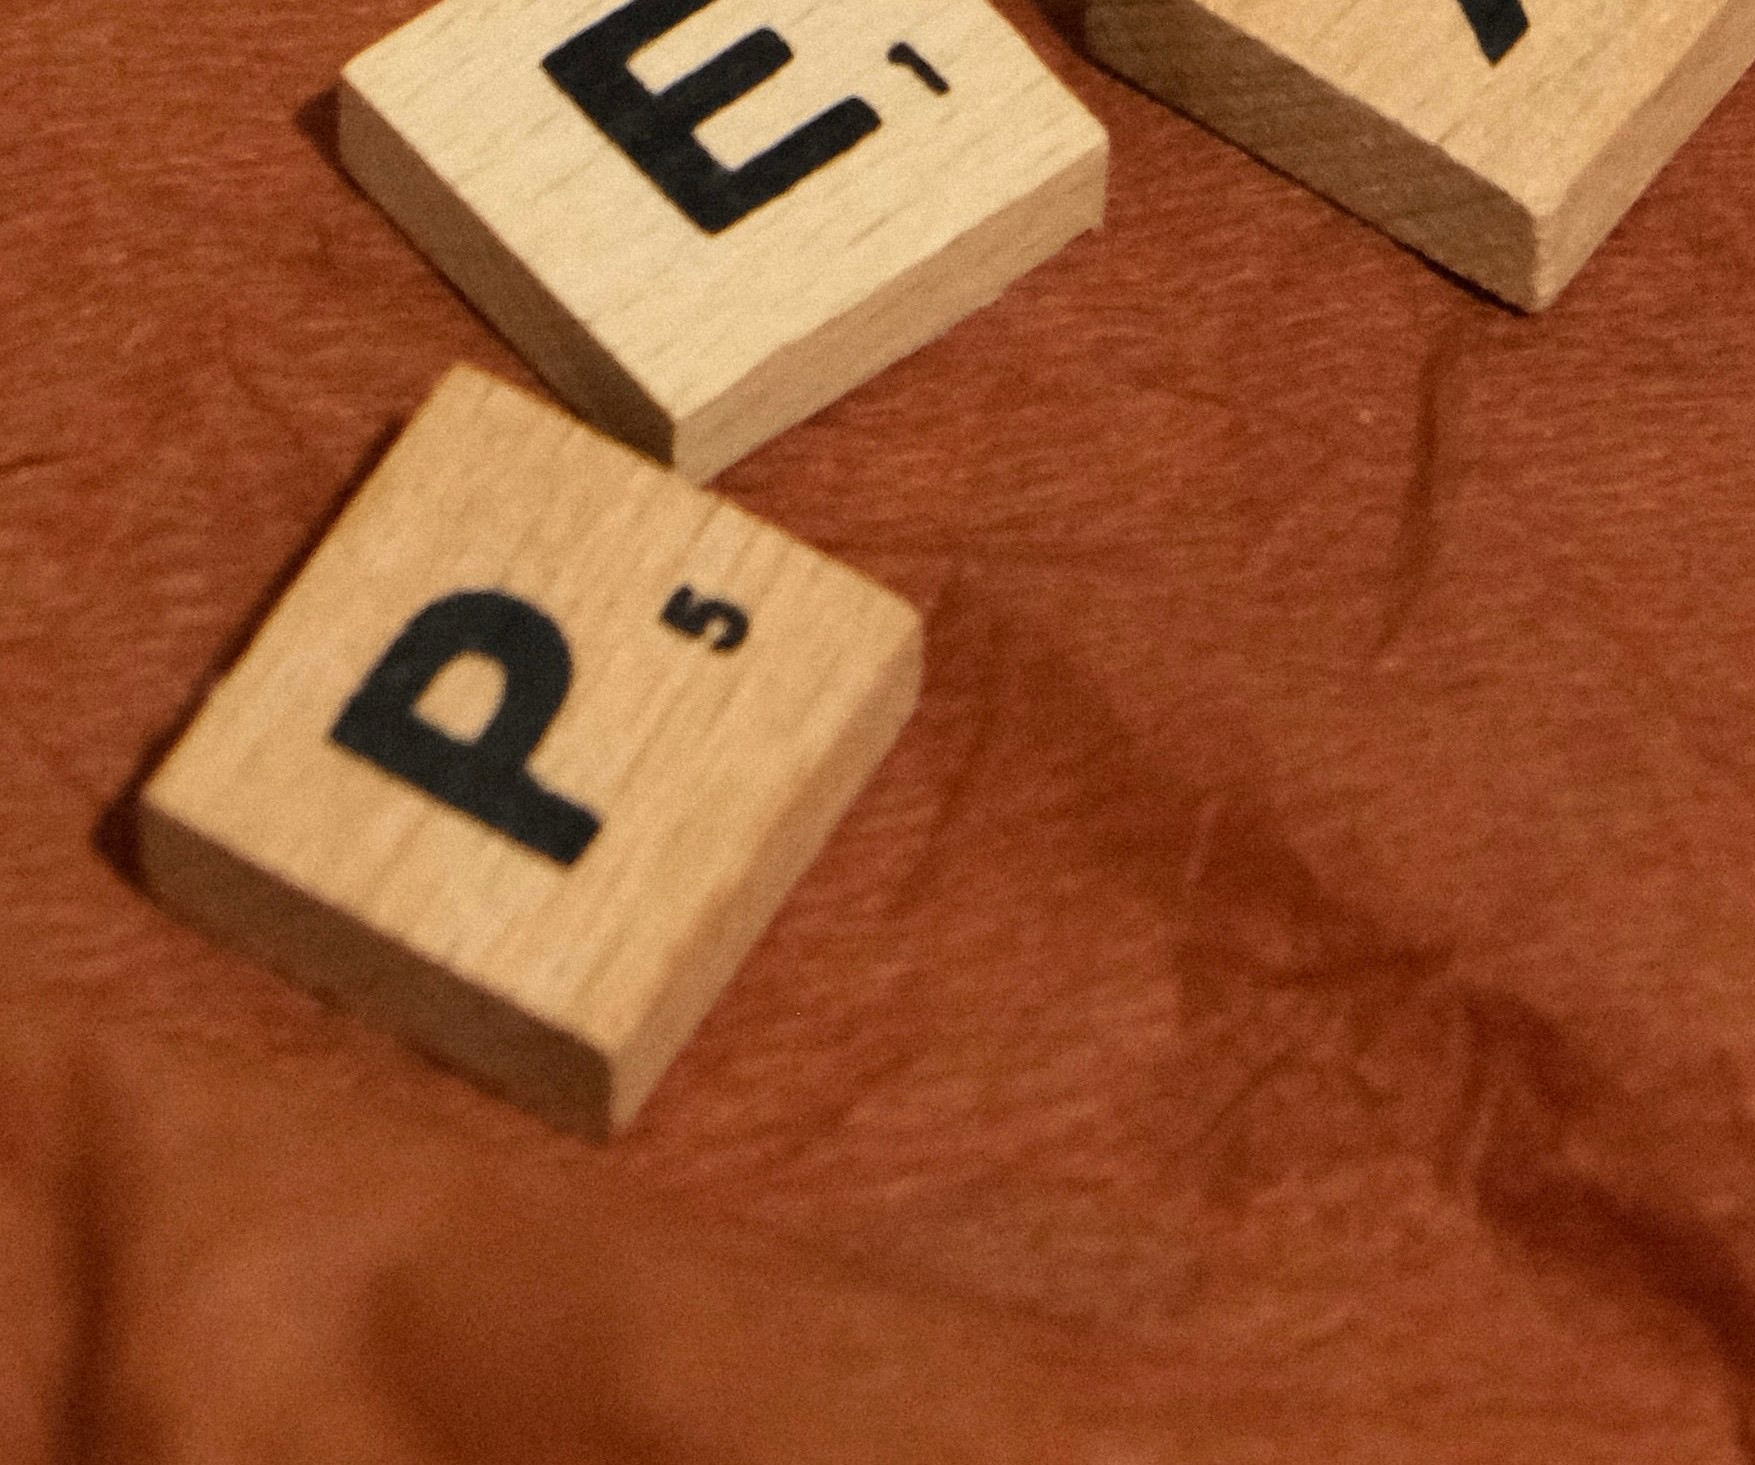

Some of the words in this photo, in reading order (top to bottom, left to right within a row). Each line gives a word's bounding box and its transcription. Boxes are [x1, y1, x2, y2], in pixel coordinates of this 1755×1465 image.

[886, 41, 951, 96] 1
[658, 584, 750, 654] 5
[328, 588, 602, 868] P
